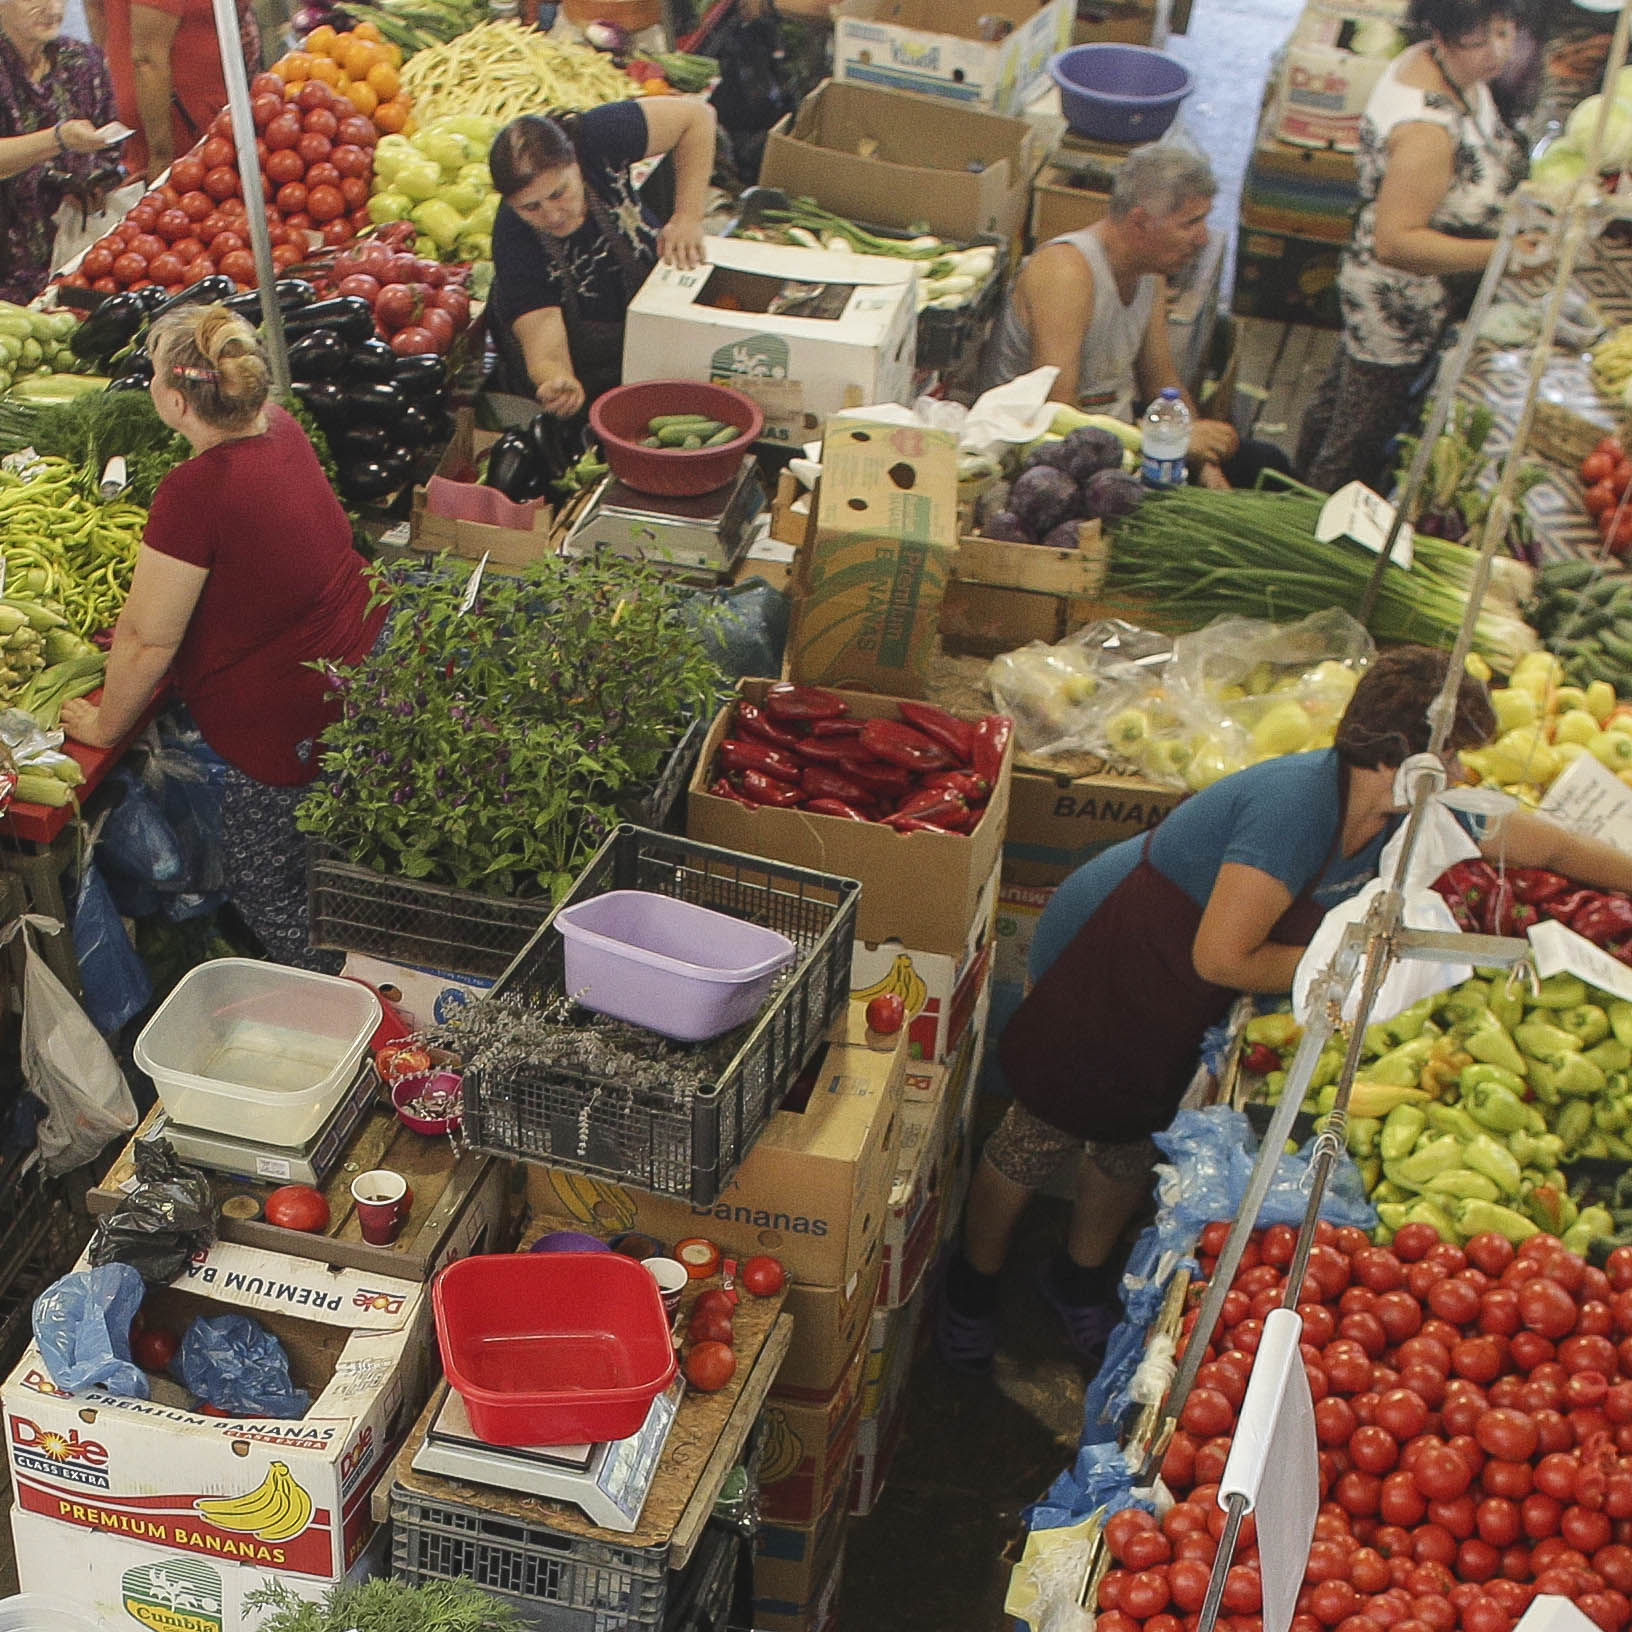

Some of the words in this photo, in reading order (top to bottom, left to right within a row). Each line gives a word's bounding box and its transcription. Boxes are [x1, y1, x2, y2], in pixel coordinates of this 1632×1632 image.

[1054, 796, 1174, 829] BANAN
[224, 1271, 343, 1312] PREMIUM
[353, 1292, 406, 1315] Dole
[85, 1393, 206, 1427] PREMIUM
[214, 1421, 337, 1441] BANANAS
[9, 1413, 111, 1467] Dole
[17, 1456, 60, 1478] CLASS
[62, 1467, 109, 1489] EXTRA
[58, 1500, 168, 1540] PREMIUM
[174, 1528, 287, 1564] BANANAS
